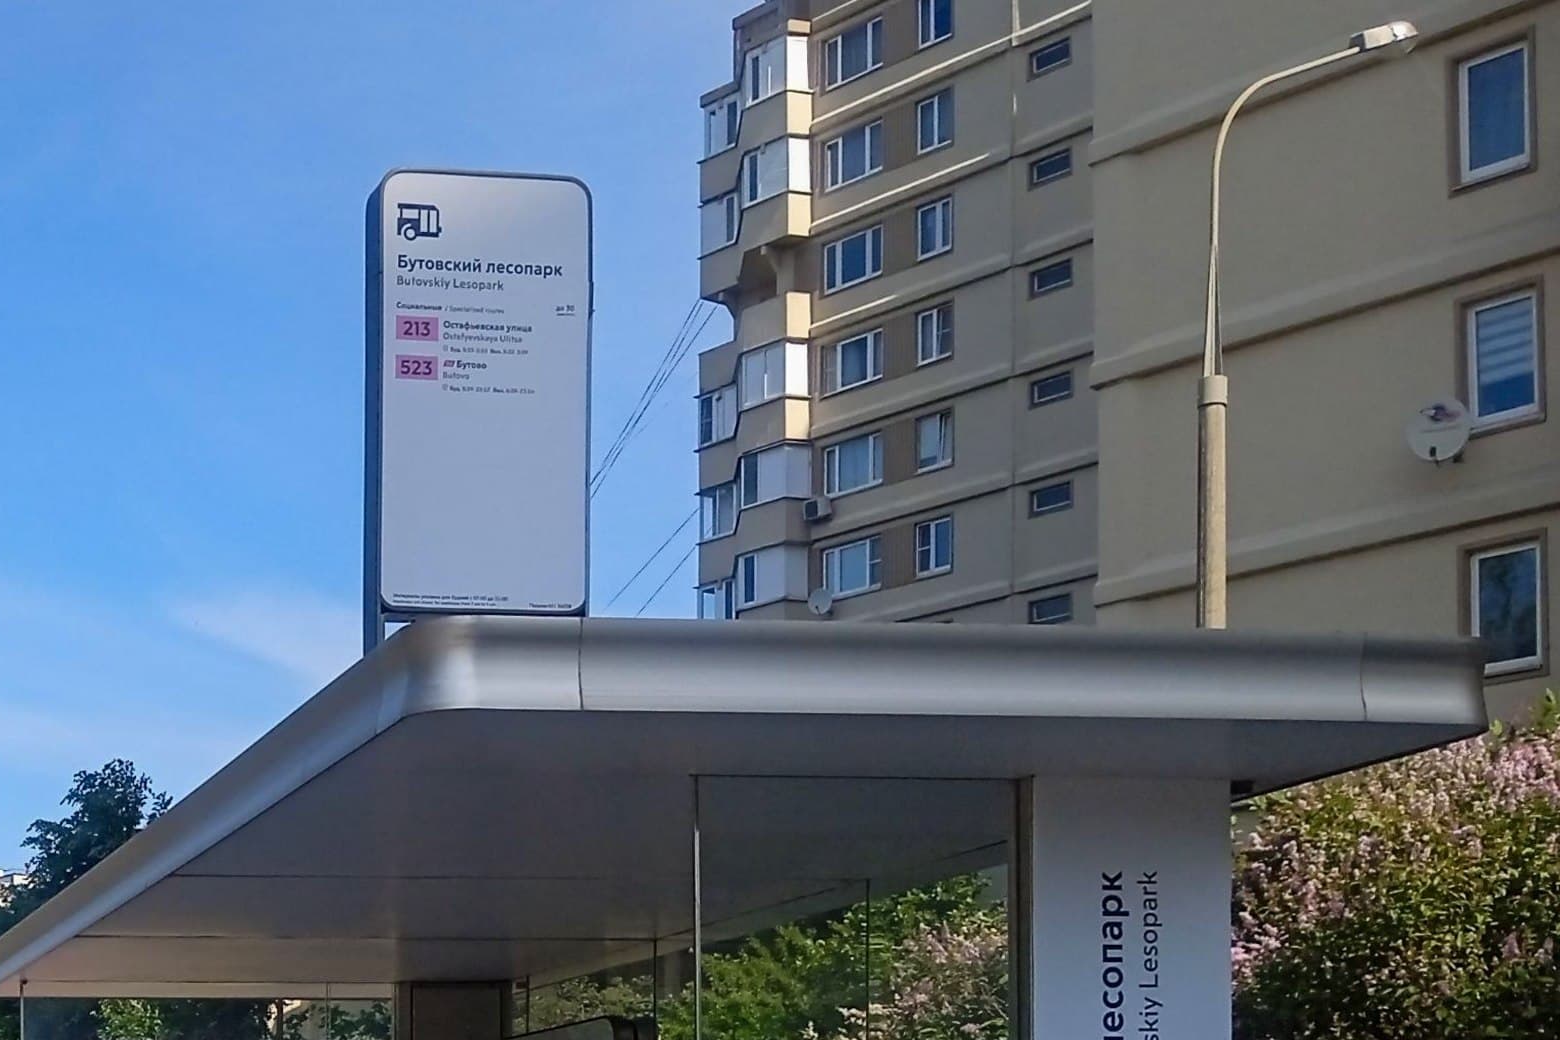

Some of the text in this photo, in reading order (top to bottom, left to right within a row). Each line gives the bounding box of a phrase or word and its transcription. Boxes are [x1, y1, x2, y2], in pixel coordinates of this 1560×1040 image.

[397, 254, 563, 279] Бутовский лесопарк
[396, 275, 504, 291] Butovskiy Lesopark
[403, 320, 431, 337] 213
[400, 360, 432, 376] 523
[456, 360, 487, 370] Бутово
[1137, 870, 1163, 988] Lesopark
